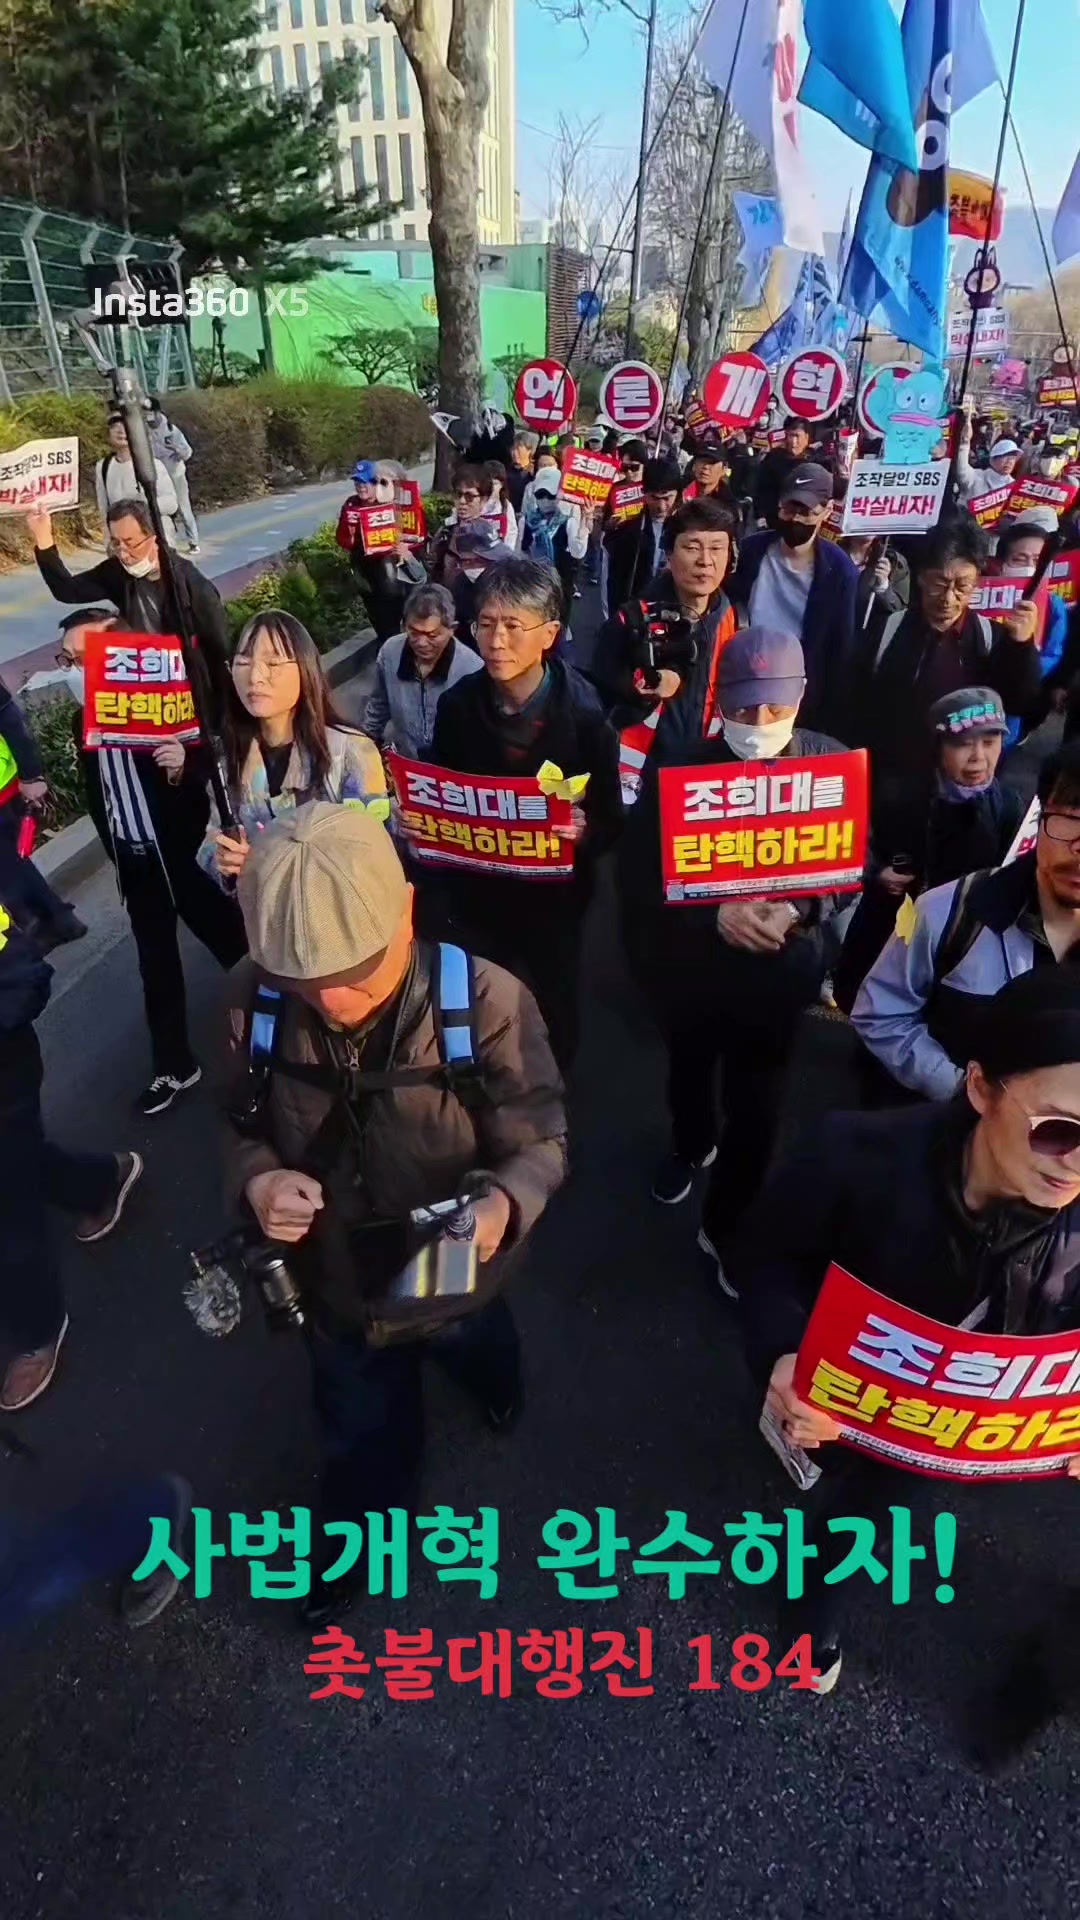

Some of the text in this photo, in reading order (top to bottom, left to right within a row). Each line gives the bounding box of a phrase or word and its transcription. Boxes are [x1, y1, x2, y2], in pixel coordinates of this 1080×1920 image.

[522, 367, 565, 421] 언
[613, 375, 651, 421] 론
[715, 361, 768, 418] 개
[790, 358, 837, 411] 혁
[47, 450, 73, 465] SBS
[854, 471, 942, 487] 조작달인 SBS
[851, 495, 936, 517] 박살내자!
[405, 771, 548, 820] 조희대를
[683, 771, 845, 822] 조희대를
[672, 819, 854, 873] 탄핵하라!
